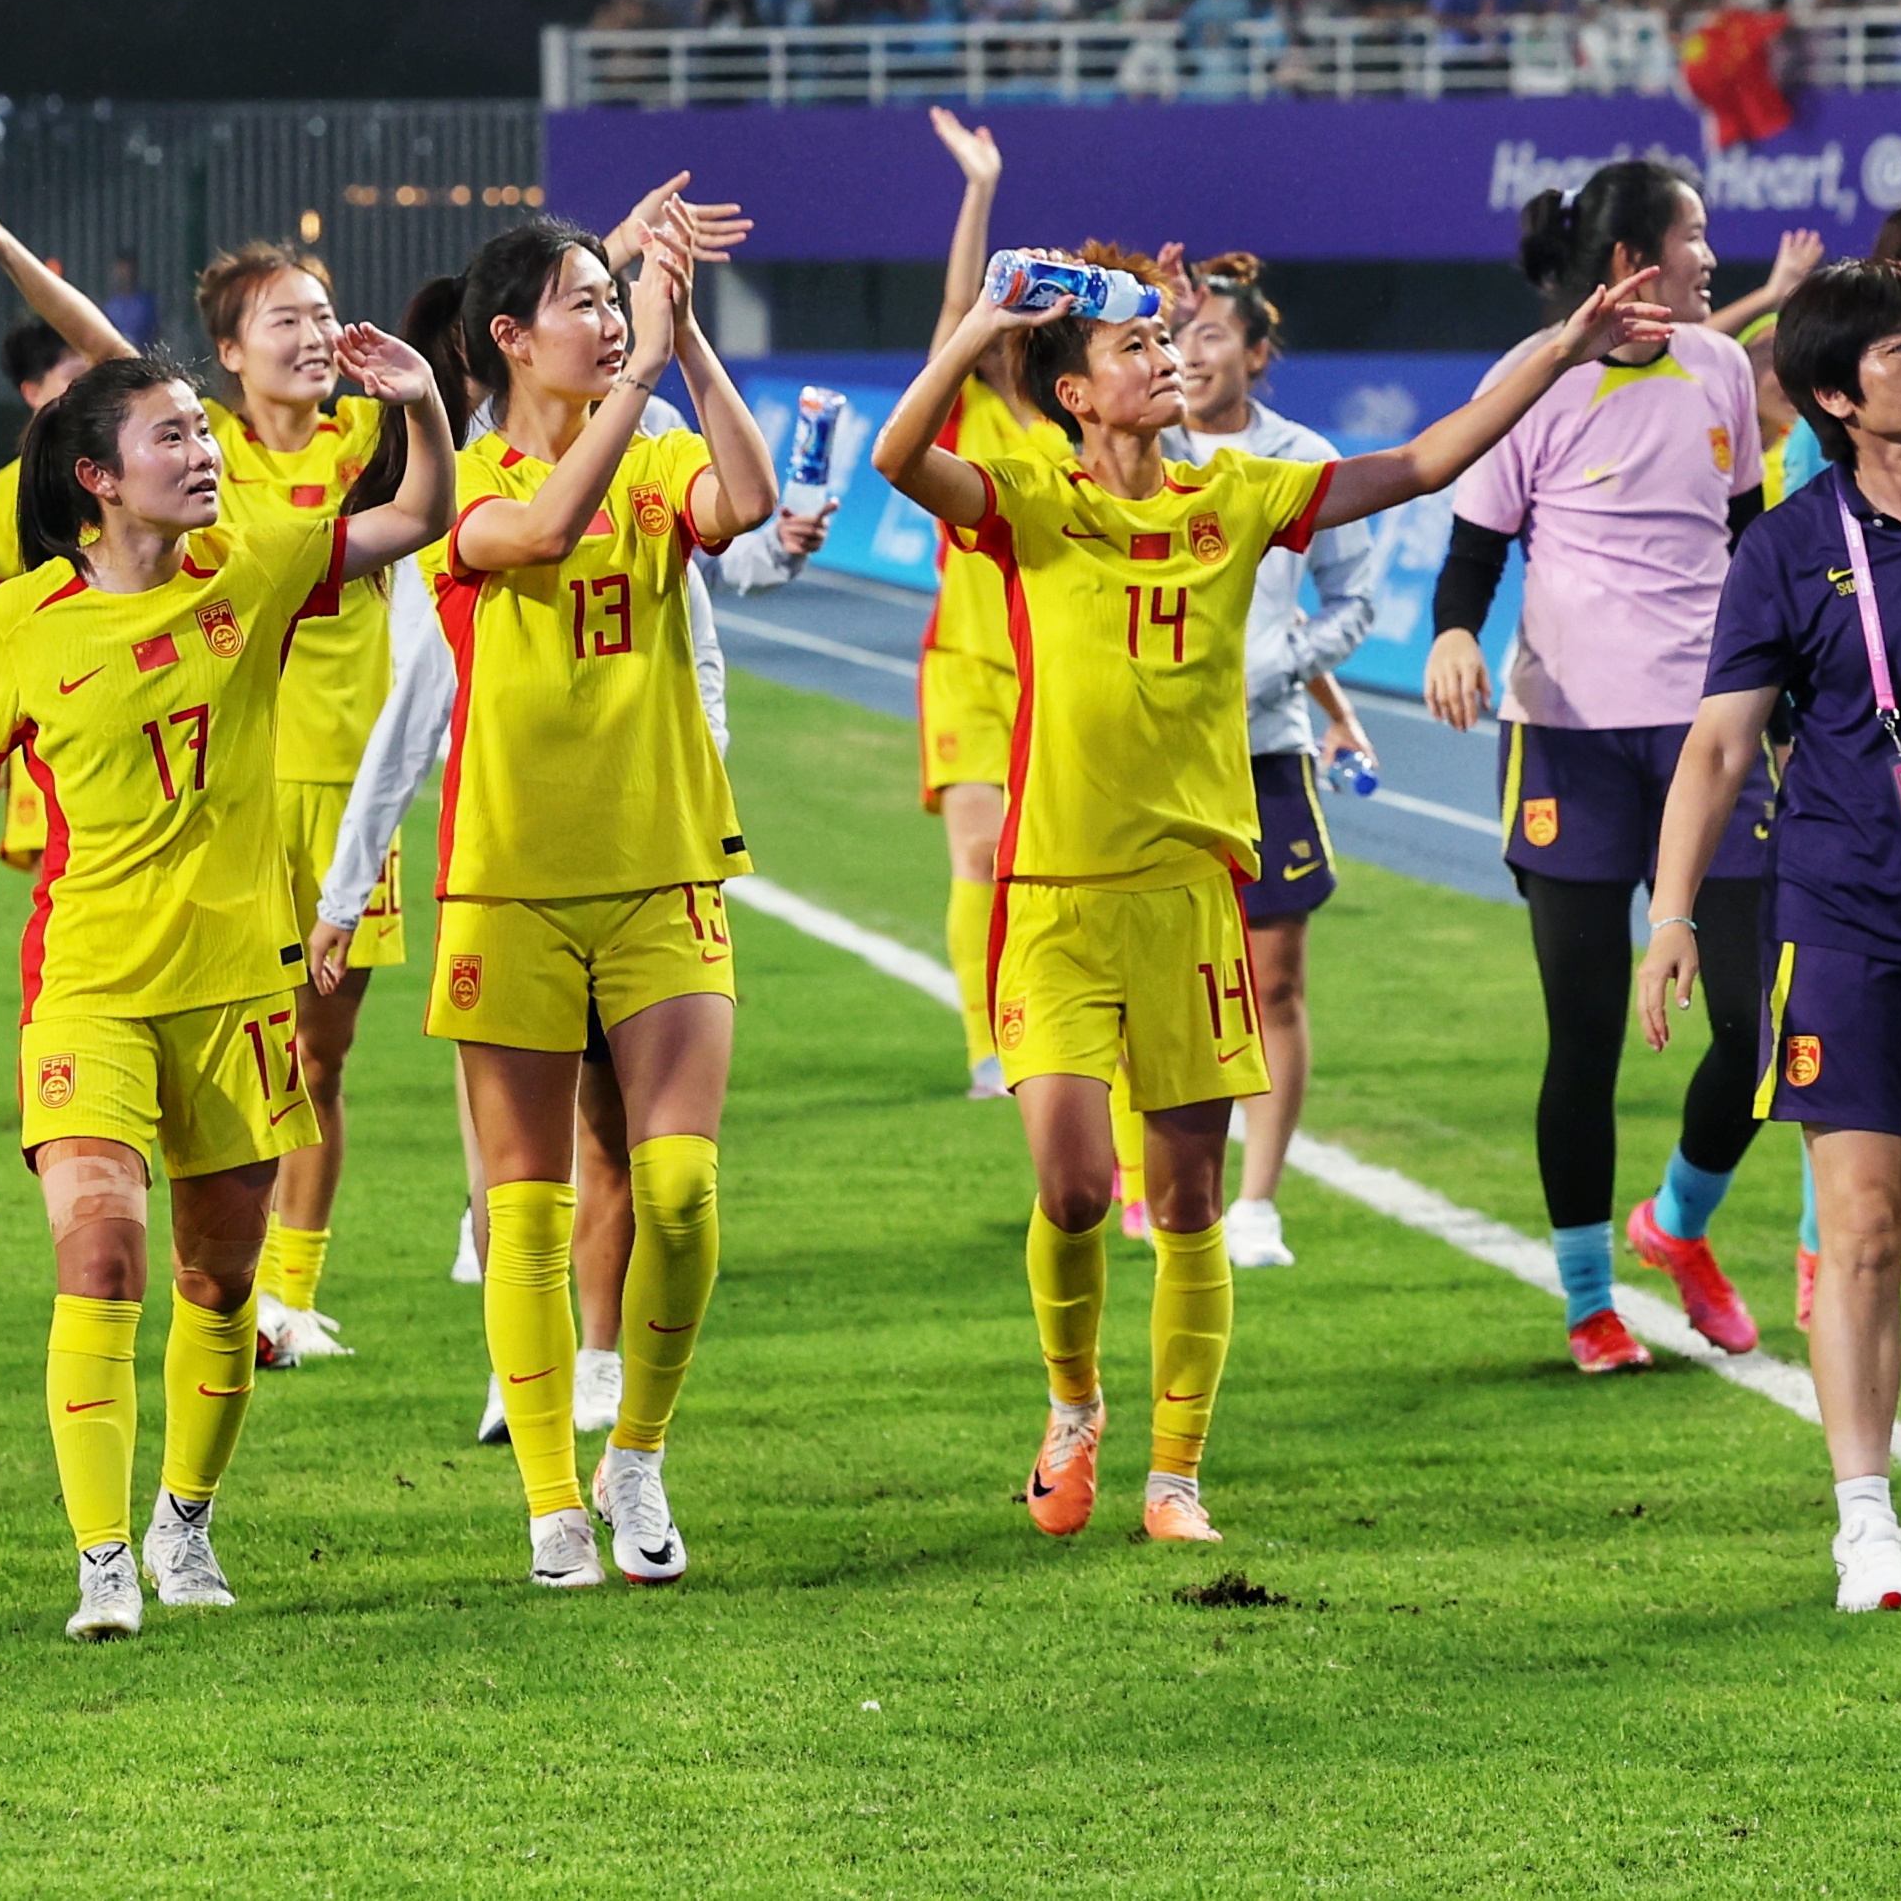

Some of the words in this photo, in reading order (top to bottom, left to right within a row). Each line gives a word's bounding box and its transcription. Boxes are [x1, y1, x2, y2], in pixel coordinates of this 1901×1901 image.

[569, 572, 634, 659] 13
[1124, 583, 1189, 664] 14
[1836, 579, 1857, 597] SHU
[141, 702, 210, 802] 17
[1197, 956, 1254, 1042] 14
[243, 1009, 299, 1101] 17
